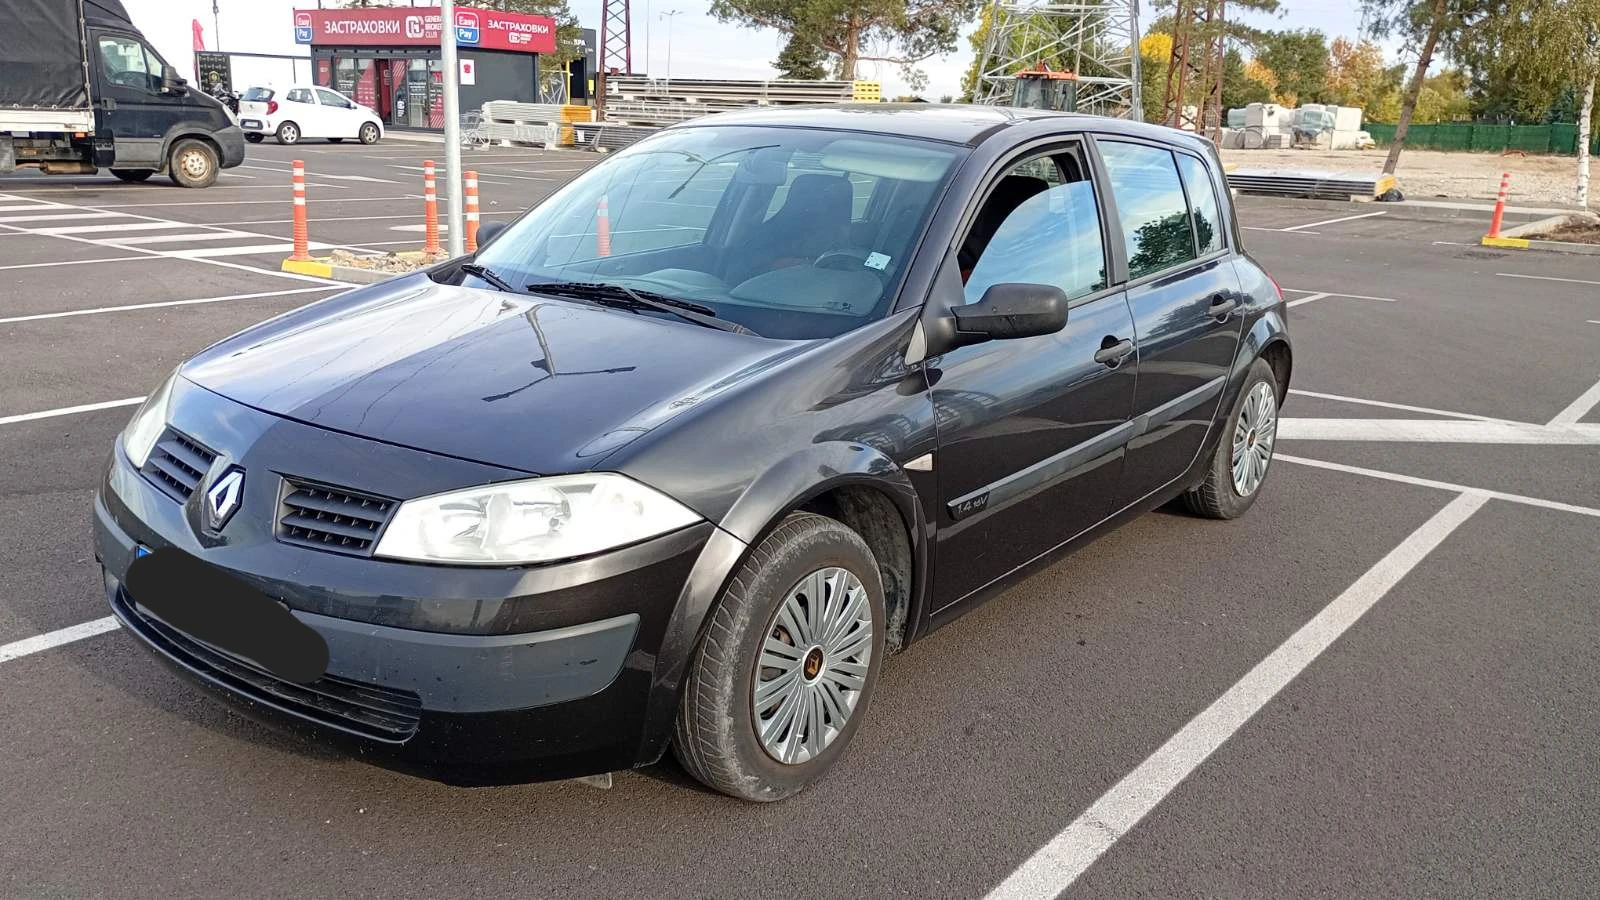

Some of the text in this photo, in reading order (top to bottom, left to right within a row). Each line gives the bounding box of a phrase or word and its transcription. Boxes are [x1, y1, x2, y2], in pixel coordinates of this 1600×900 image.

[298, 17, 309, 26] Easy
[458, 16, 475, 27] Easy
[324, 20, 400, 34] ЗАСТРАХОВКИ
[487, 20, 549, 34] ЗАСТРАХОВКИ
[299, 29, 308, 37] Pay
[459, 29, 473, 39] Pay
